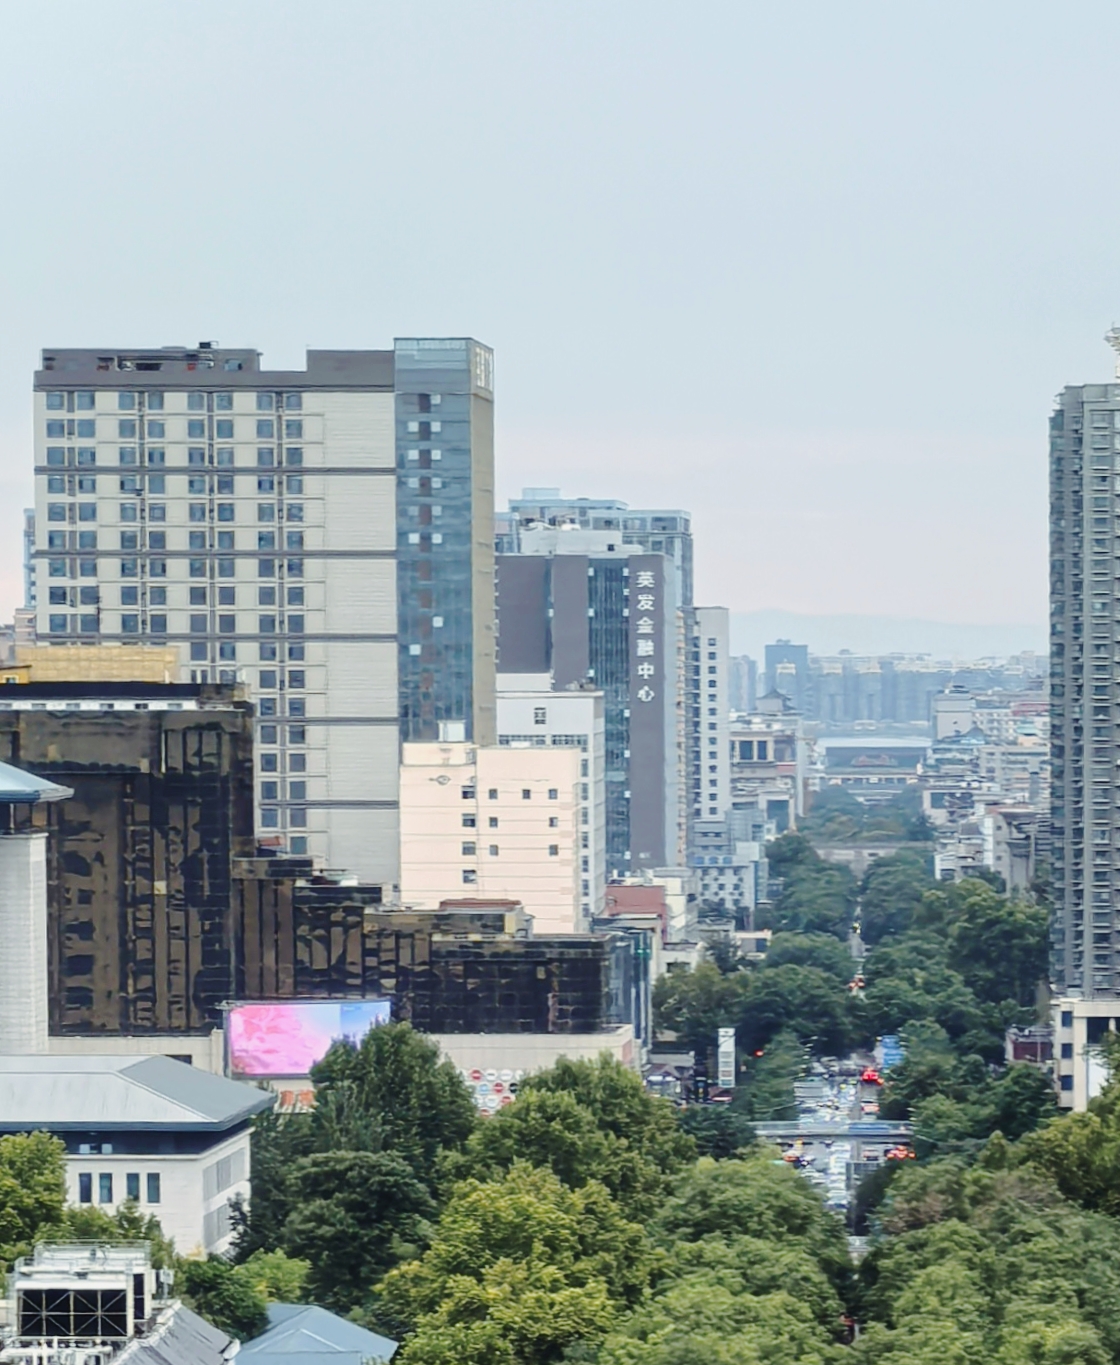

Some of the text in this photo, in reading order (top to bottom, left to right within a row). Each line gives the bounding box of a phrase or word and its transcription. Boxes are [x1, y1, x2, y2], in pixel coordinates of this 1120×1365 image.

[636, 571, 655, 702] 英发金融中心
